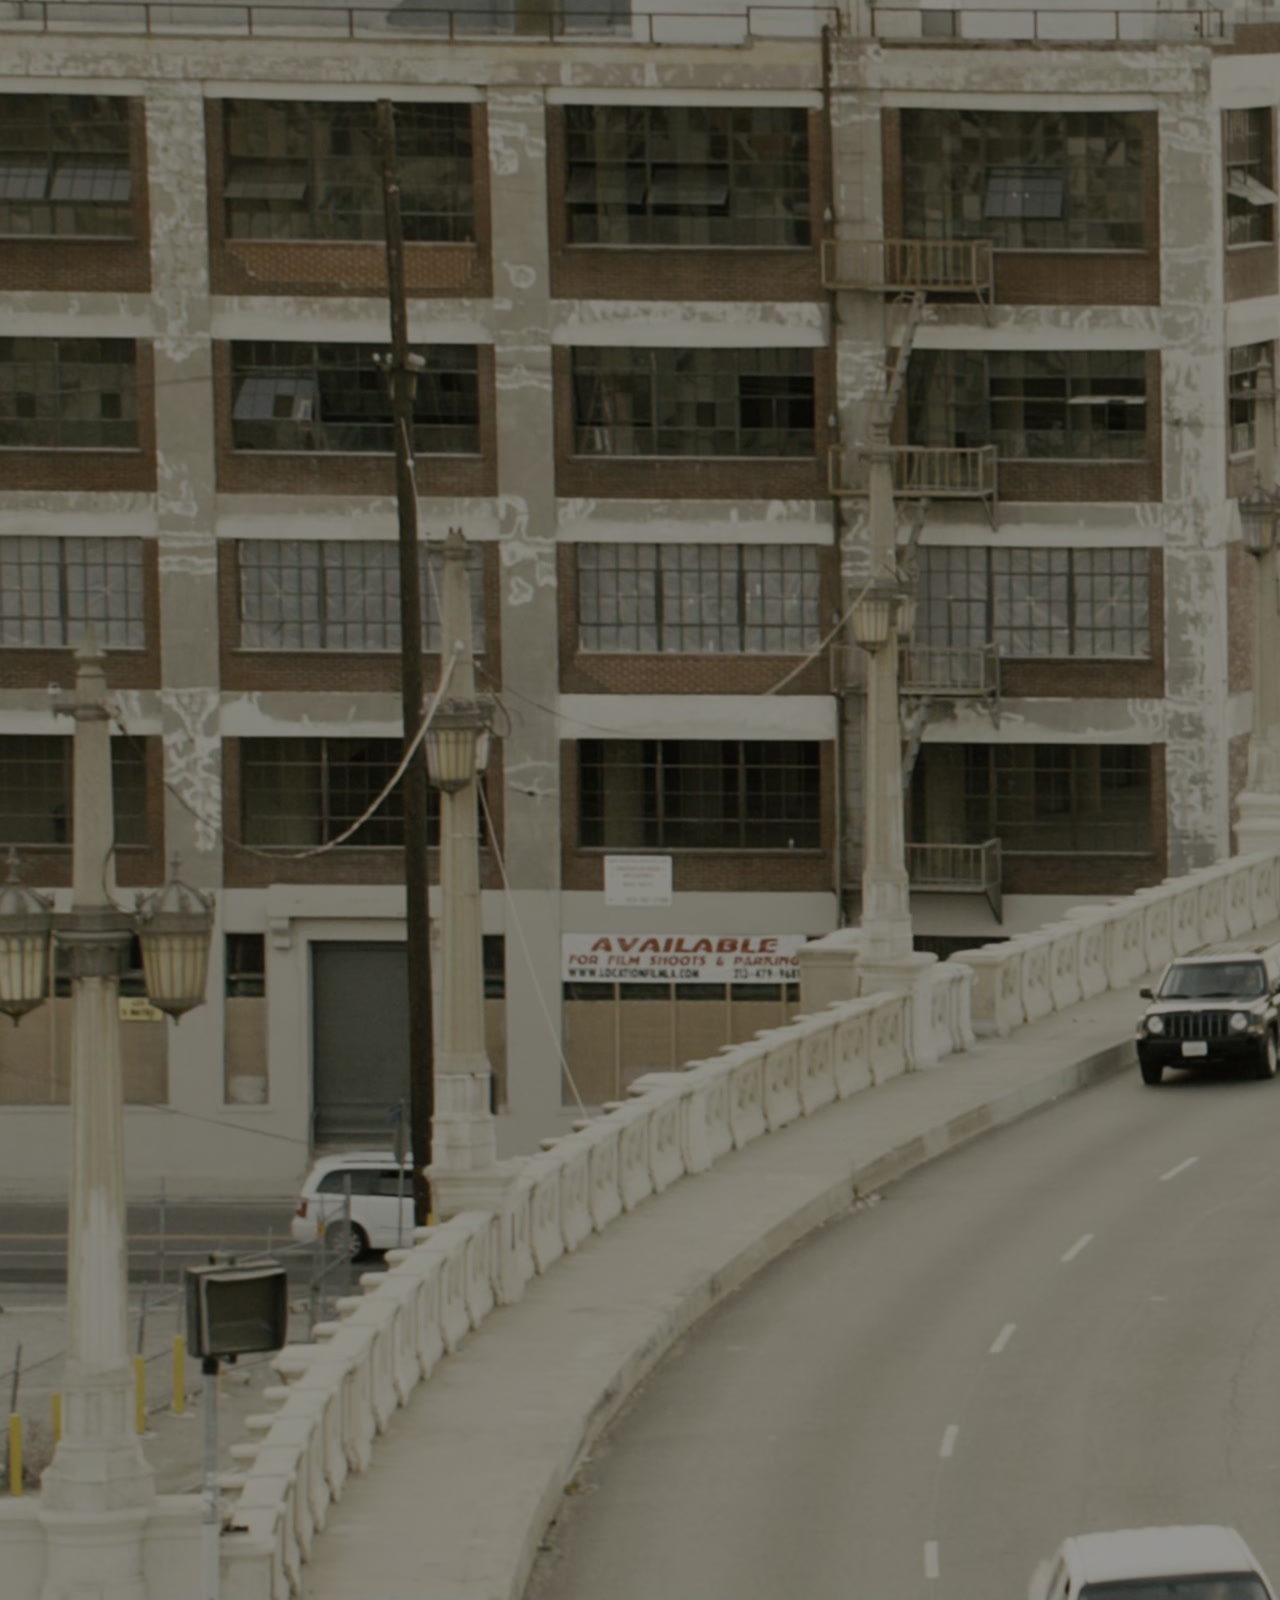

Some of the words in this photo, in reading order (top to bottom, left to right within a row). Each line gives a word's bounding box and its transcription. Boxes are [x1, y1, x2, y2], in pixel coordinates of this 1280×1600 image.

[591, 937, 778, 953] AVAILABLE
[568, 955, 599, 965] FOR
[607, 955, 641, 966] FILM
[650, 955, 706, 966] SHOOTS
[734, 956, 800, 967] PARKING
